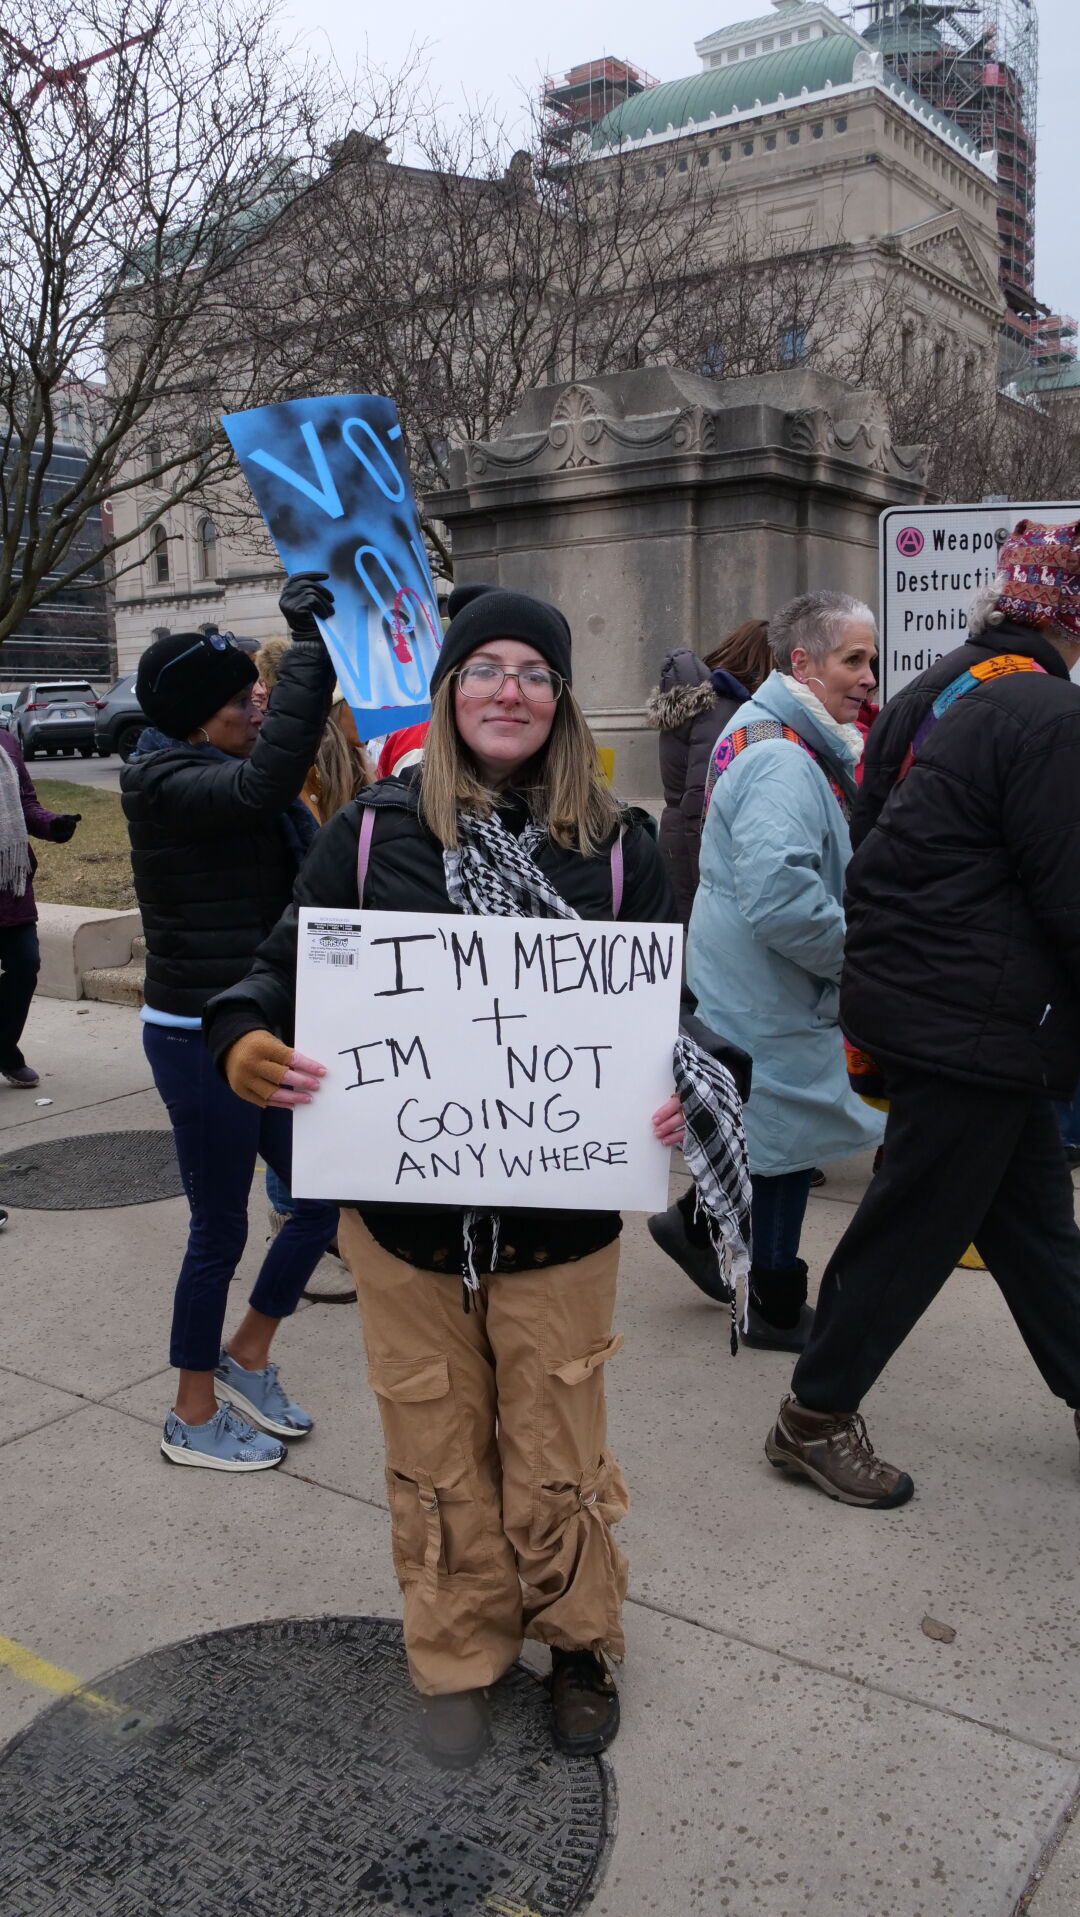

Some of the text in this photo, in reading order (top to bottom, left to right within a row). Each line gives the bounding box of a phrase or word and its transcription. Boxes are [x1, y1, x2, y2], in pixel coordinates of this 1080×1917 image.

[247, 417, 405, 519] VO
[932, 529, 993, 553] Weapo
[904, 608, 968, 632] Prohib
[371, 928, 673, 996] I'M MEXICAN
[472, 998, 527, 1045] +
[508, 1045, 612, 1088] NOT
[398, 1094, 579, 1143] GOING
[395, 1142, 628, 1184] ANYWHERE
